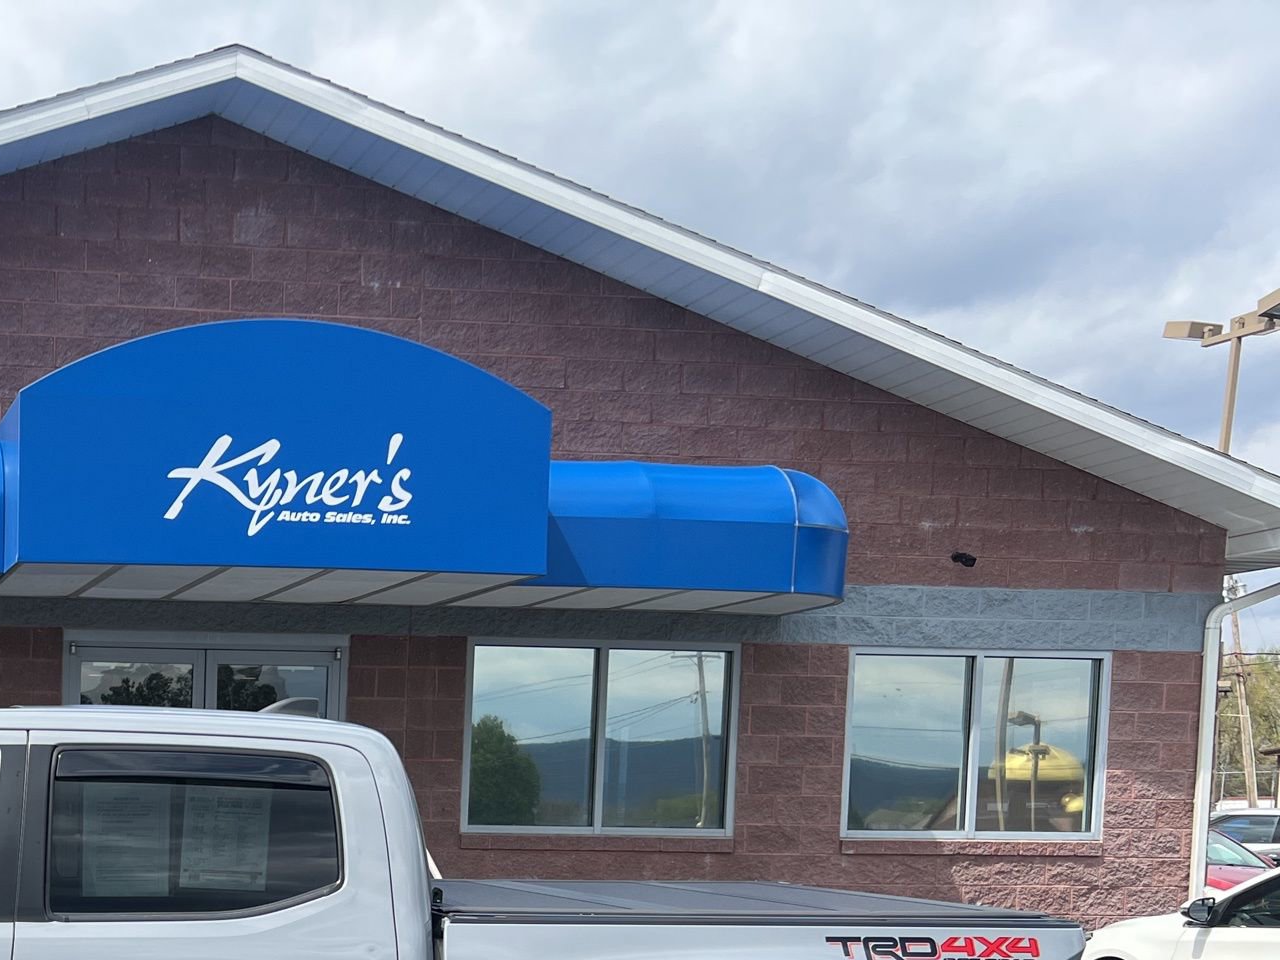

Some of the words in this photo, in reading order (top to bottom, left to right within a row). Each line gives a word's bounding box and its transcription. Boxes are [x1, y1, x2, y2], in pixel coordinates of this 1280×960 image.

[164, 433, 413, 537] Kyner's
[277, 509, 320, 523] Auto
[323, 510, 376, 526] Sales,
[380, 512, 412, 525] Inc.
